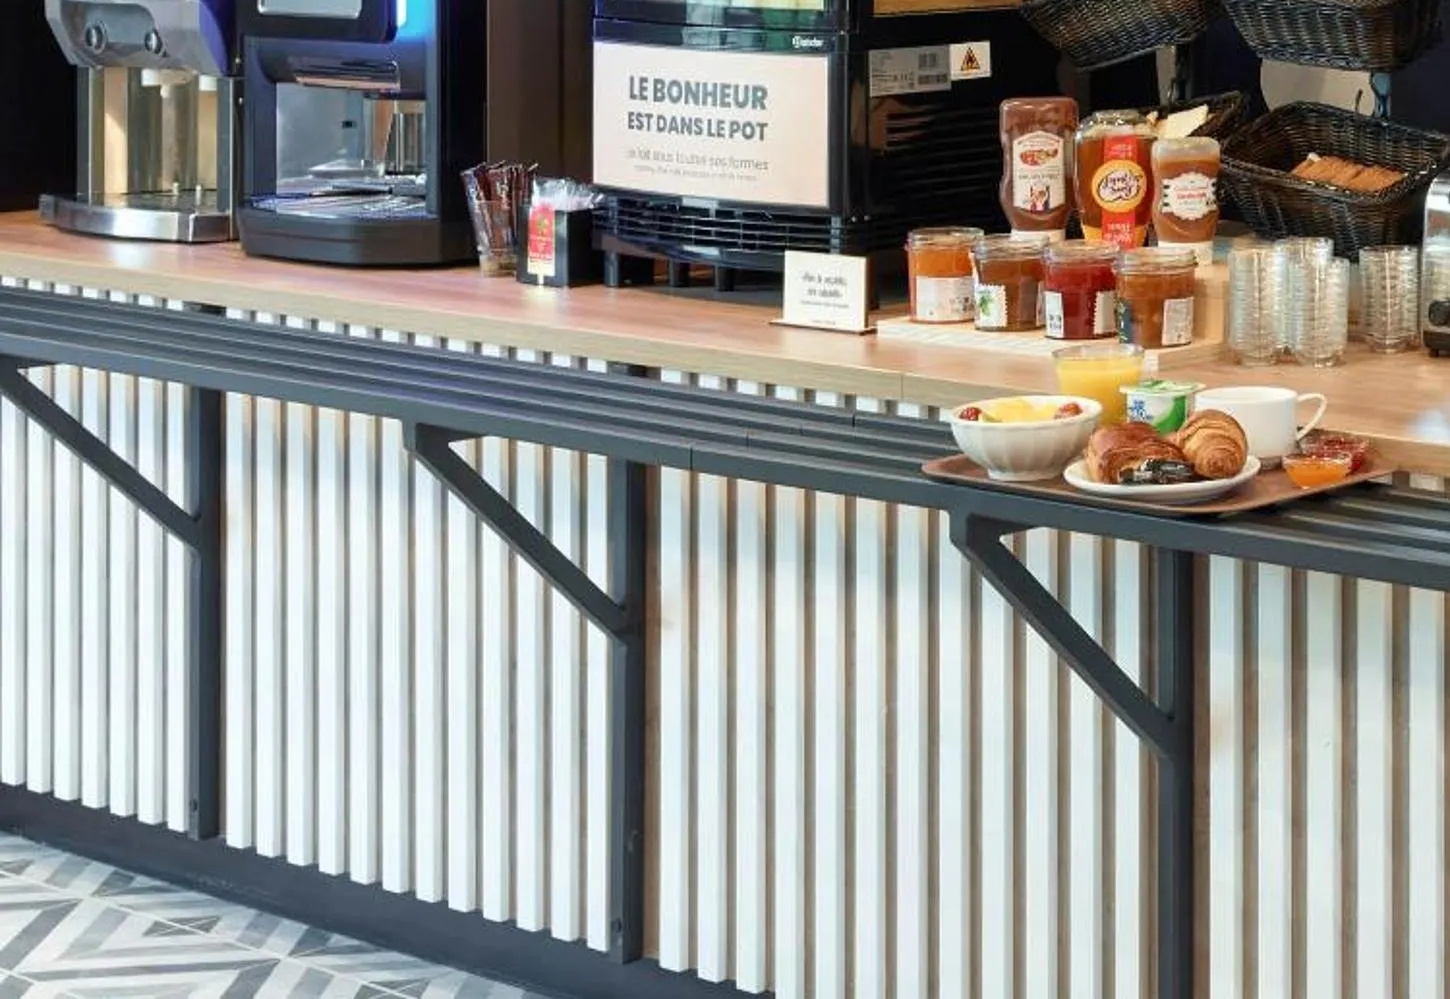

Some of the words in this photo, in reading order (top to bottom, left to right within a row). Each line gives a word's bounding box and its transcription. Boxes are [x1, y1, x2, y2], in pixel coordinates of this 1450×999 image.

[629, 75, 649, 101] LE
[653, 78, 769, 110] BONHEUR
[627, 112, 654, 132] EST
[656, 115, 704, 136] DANS
[707, 119, 725, 138] LE
[729, 121, 769, 141] POT
